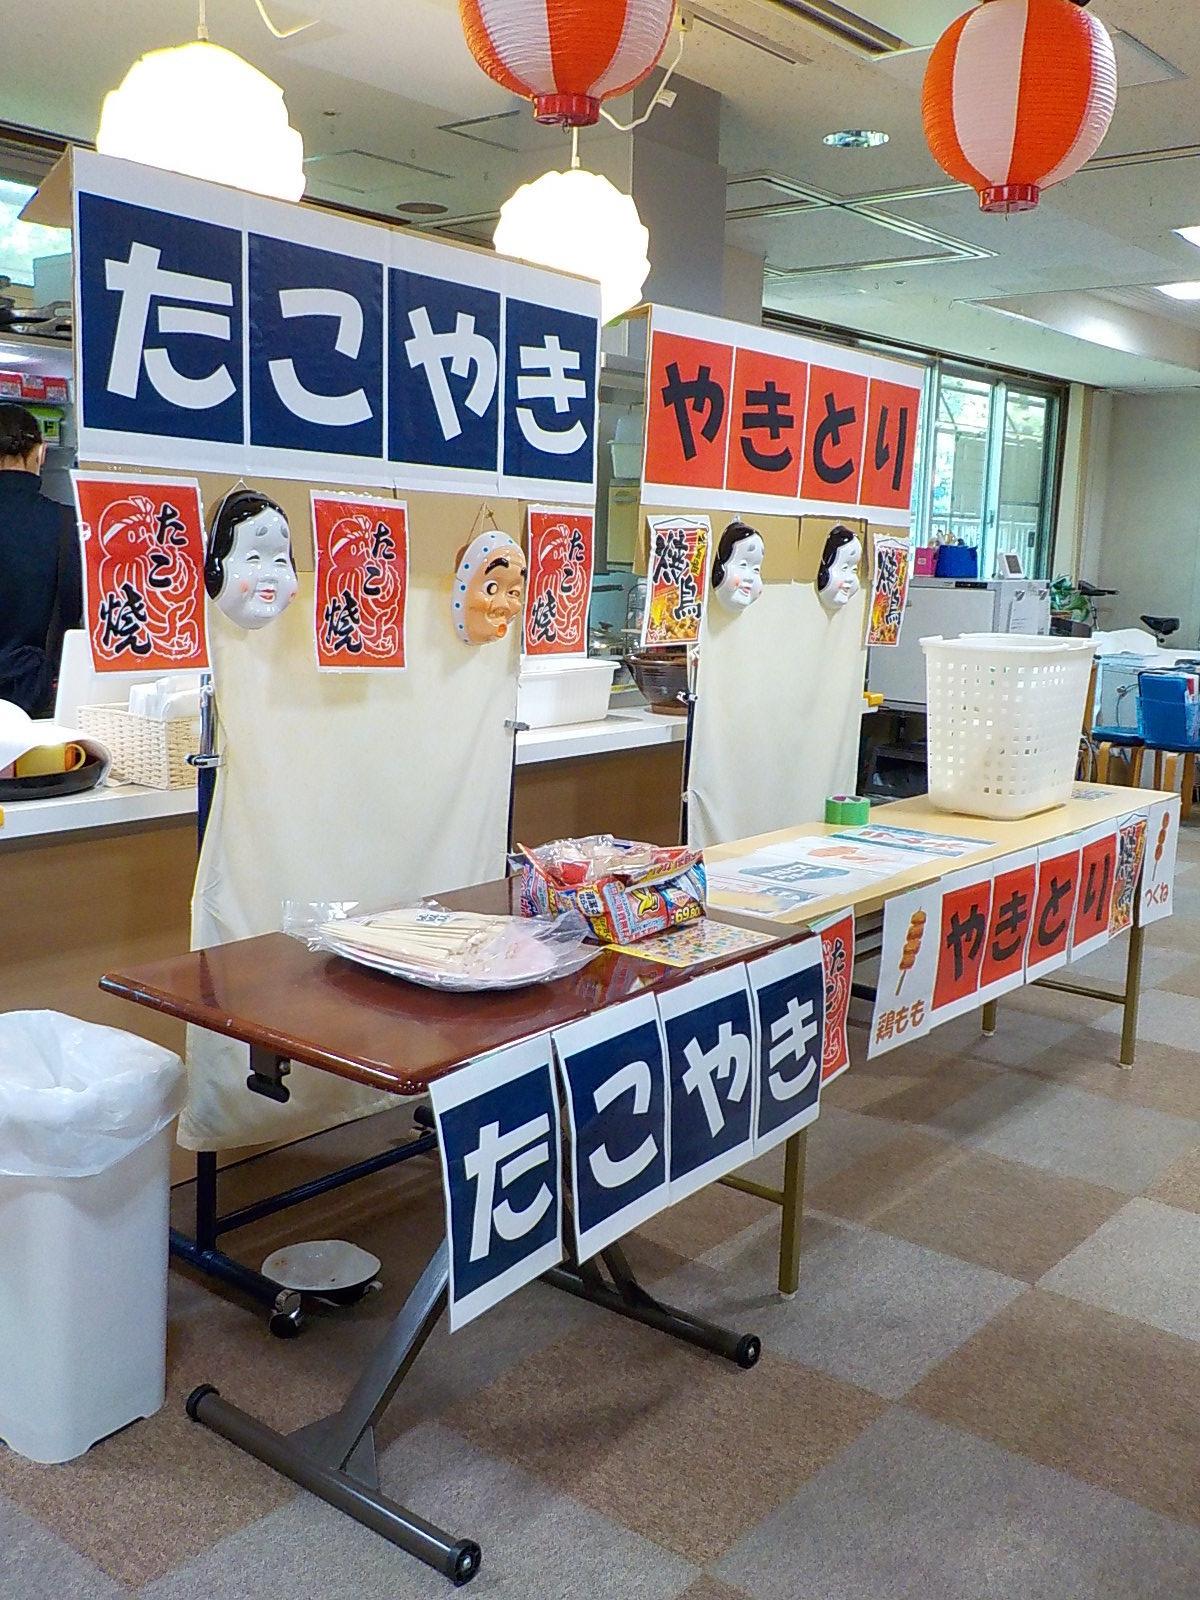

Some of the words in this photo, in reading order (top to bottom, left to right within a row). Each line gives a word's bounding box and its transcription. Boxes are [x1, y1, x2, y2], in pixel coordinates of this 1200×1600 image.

[104, 242, 588, 454] たこやき
[661, 362, 908, 490] やきとり
[946, 854, 1109, 980] やきとり
[1145, 882, 1169, 907] つくね
[875, 1000, 925, 1044] 鶏もも
[464, 998, 819, 1262] たこやき
